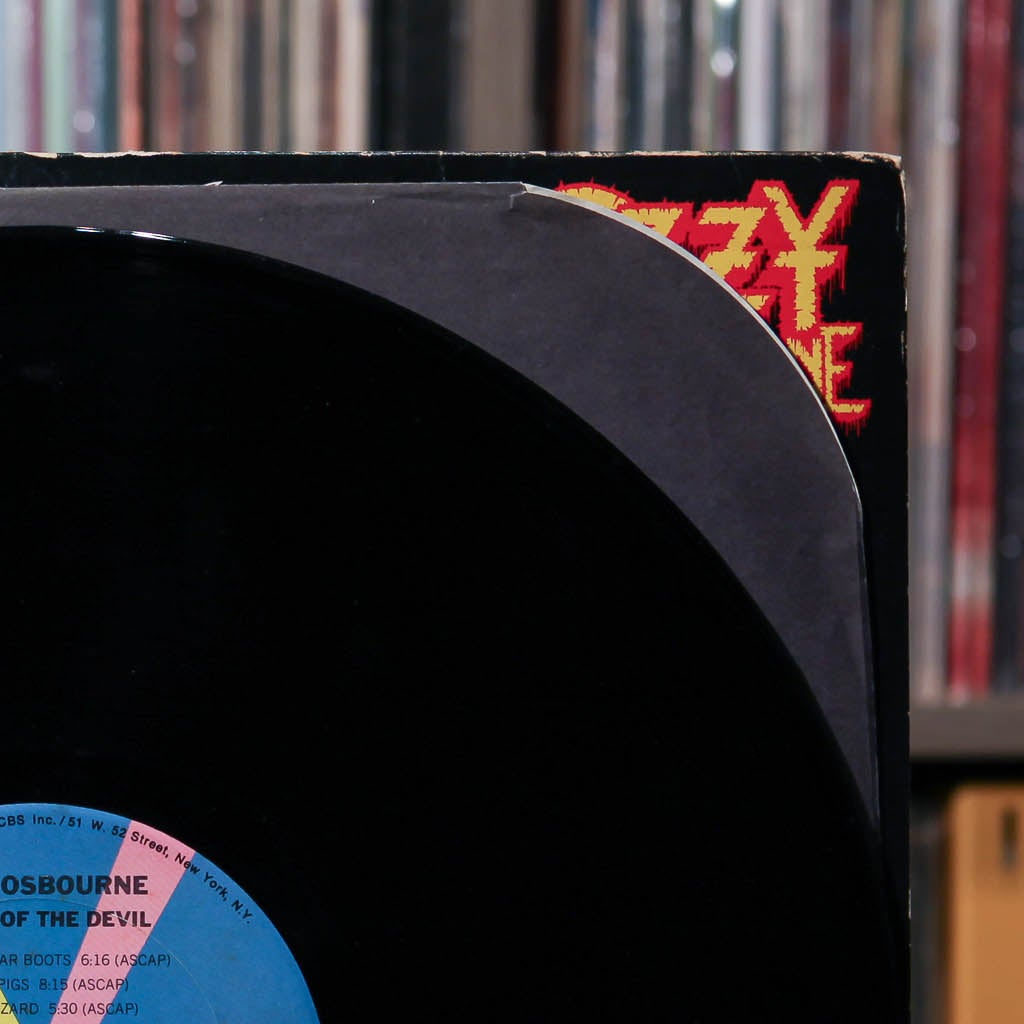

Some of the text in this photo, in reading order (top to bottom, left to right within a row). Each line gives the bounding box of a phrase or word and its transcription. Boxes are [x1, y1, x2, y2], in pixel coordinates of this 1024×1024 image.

[91, 820, 106, 832] W.
[112, 826, 127, 838] 52
[131, 831, 169, 858] Street,
[175, 853, 201, 874] New
[203, 873, 229, 902] York,
[232, 900, 254, 925] N.Y.
[1, 875, 149, 895] OSBOURNE
[0, 911, 29, 928] OF
[37, 911, 79, 928] THE
[88, 911, 151, 928] DEVIL
[24, 954, 71, 966] BOOTS
[81, 954, 110, 966] 6:16
[115, 953, 171, 967] (ASCAP)
[39, 978, 68, 990] 8:15
[73, 978, 129, 991] (ASCAP)
[49, 1003, 77, 1015] 5:30
[83, 1003, 139, 1016] (ASCAP)
